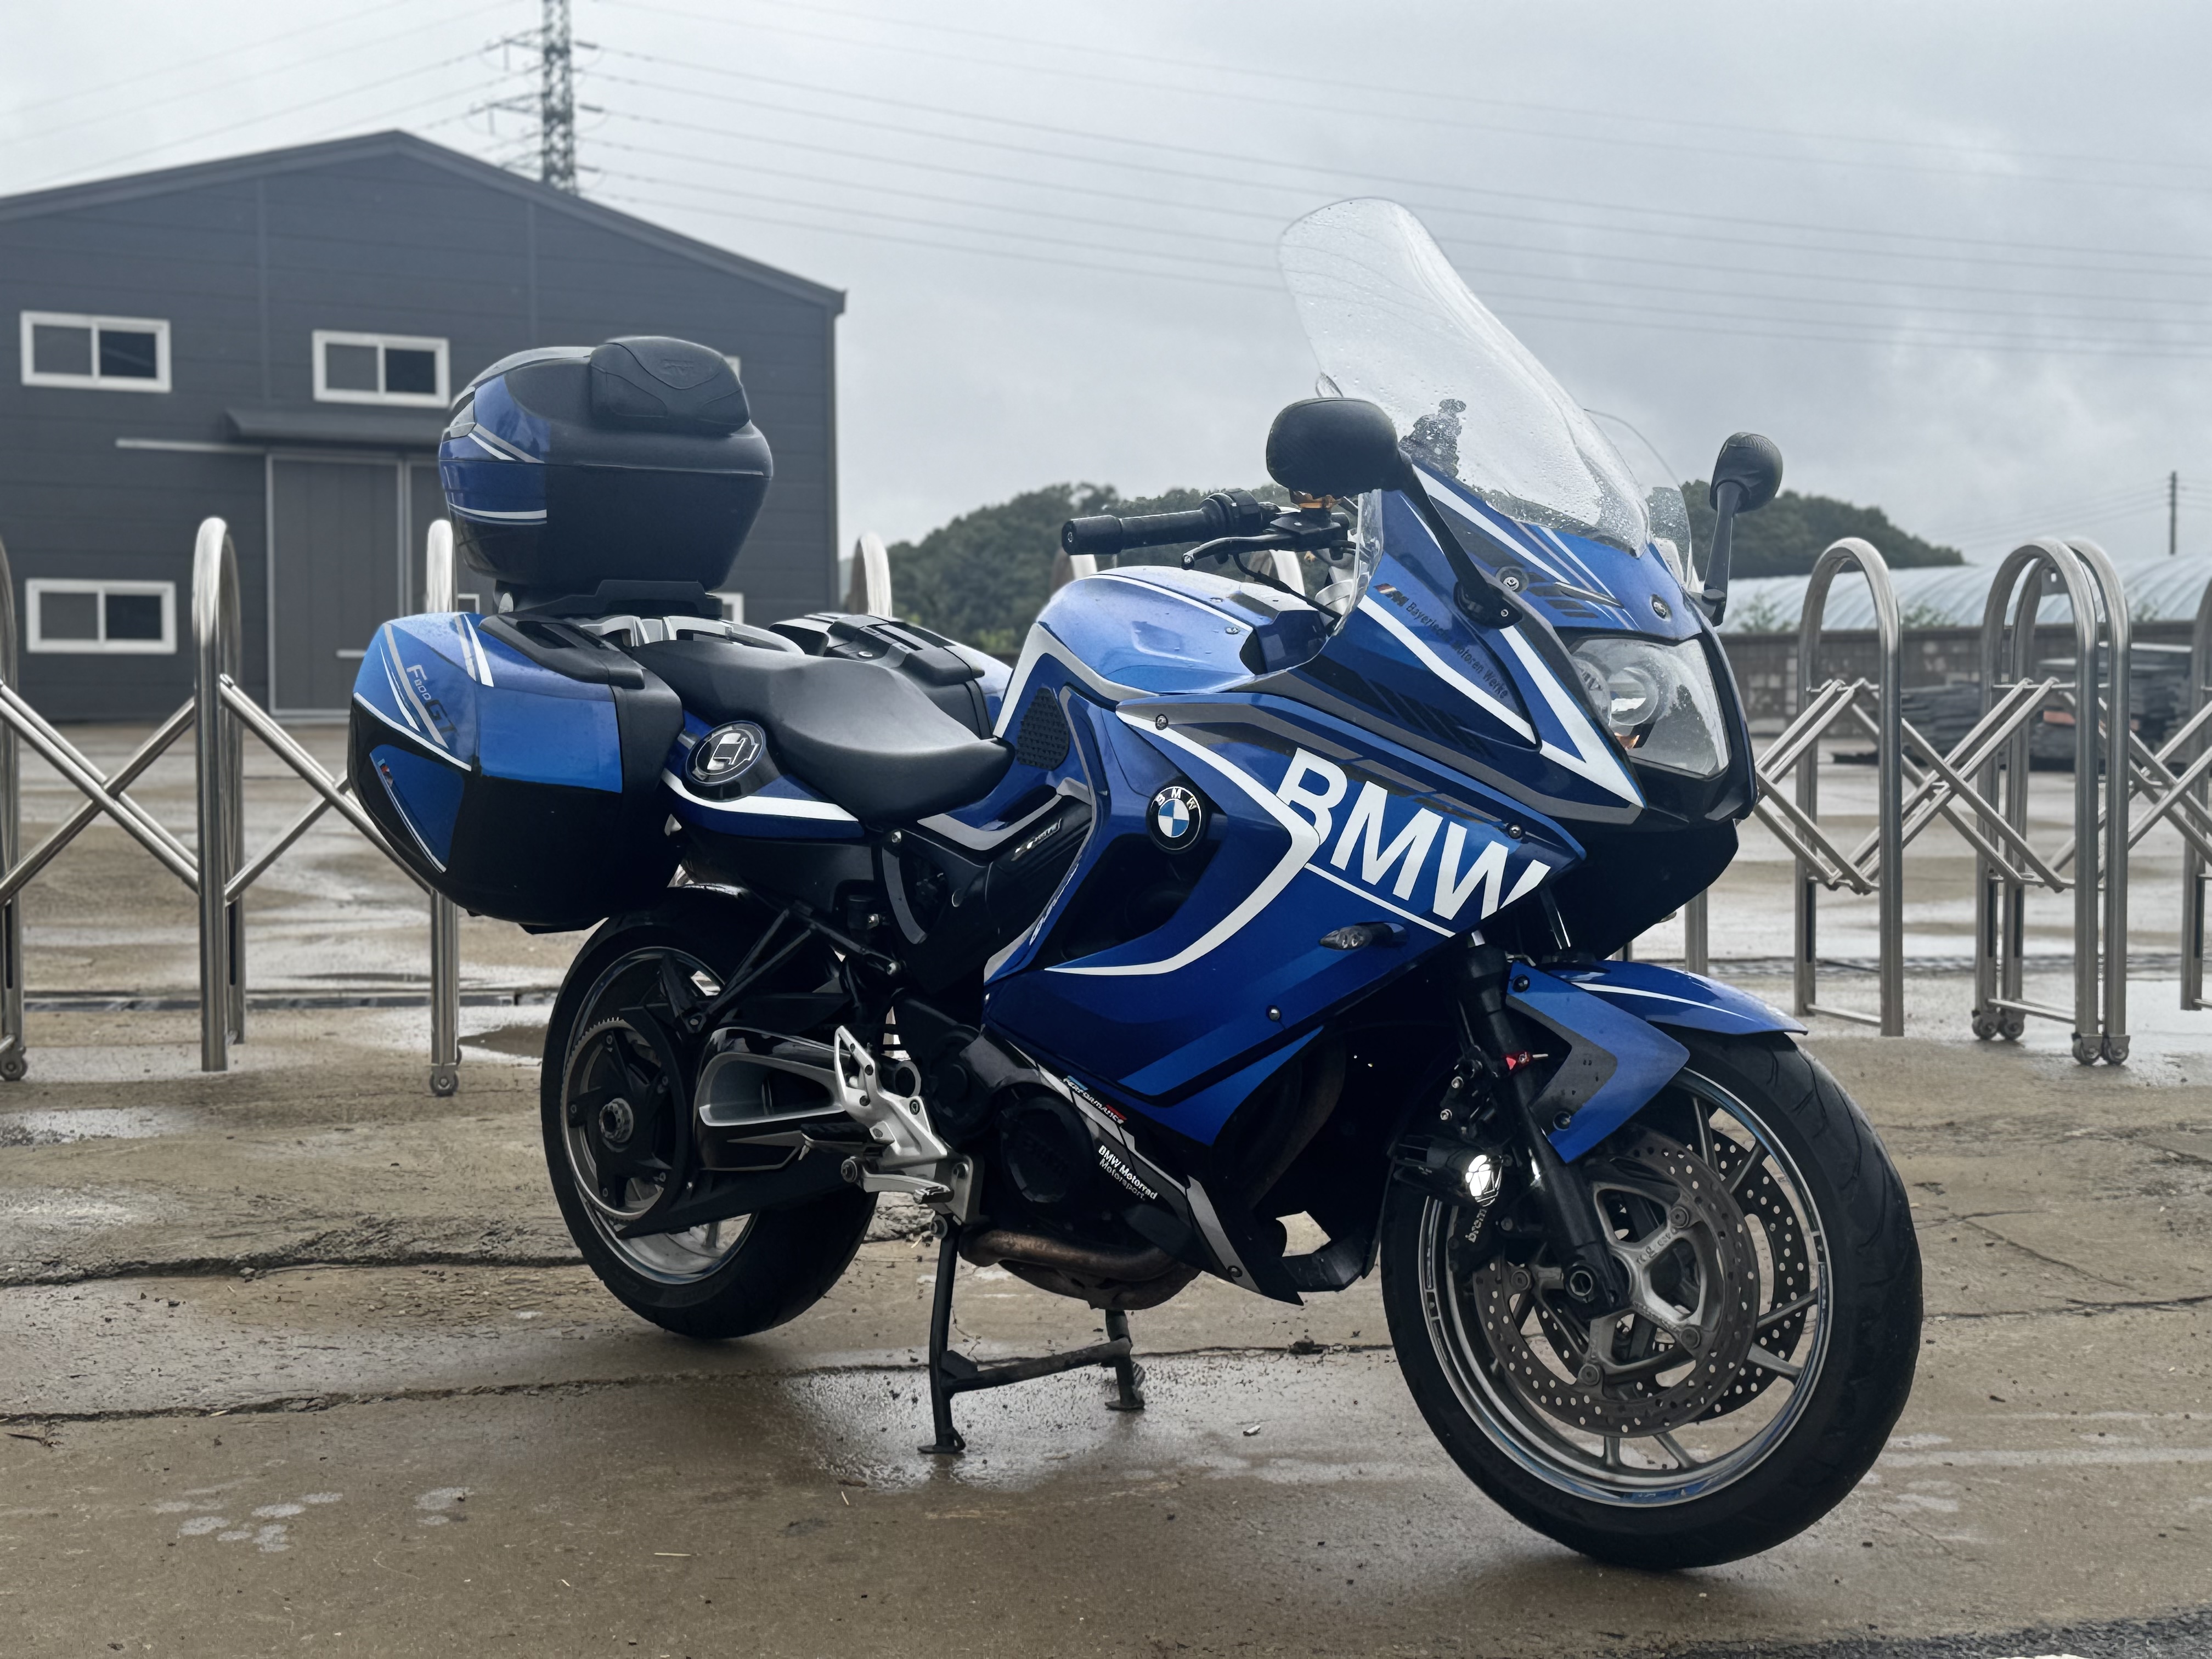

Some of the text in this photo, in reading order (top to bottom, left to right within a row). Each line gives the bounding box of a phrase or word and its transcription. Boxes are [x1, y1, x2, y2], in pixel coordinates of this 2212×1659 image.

[1483, 669, 1509, 699] Werke
[1156, 788, 1197, 810] BMW
[1276, 748, 1551, 921] BMW
[1098, 1145, 1121, 1168] BMW
[1119, 1165, 1158, 1200] Motorrad
